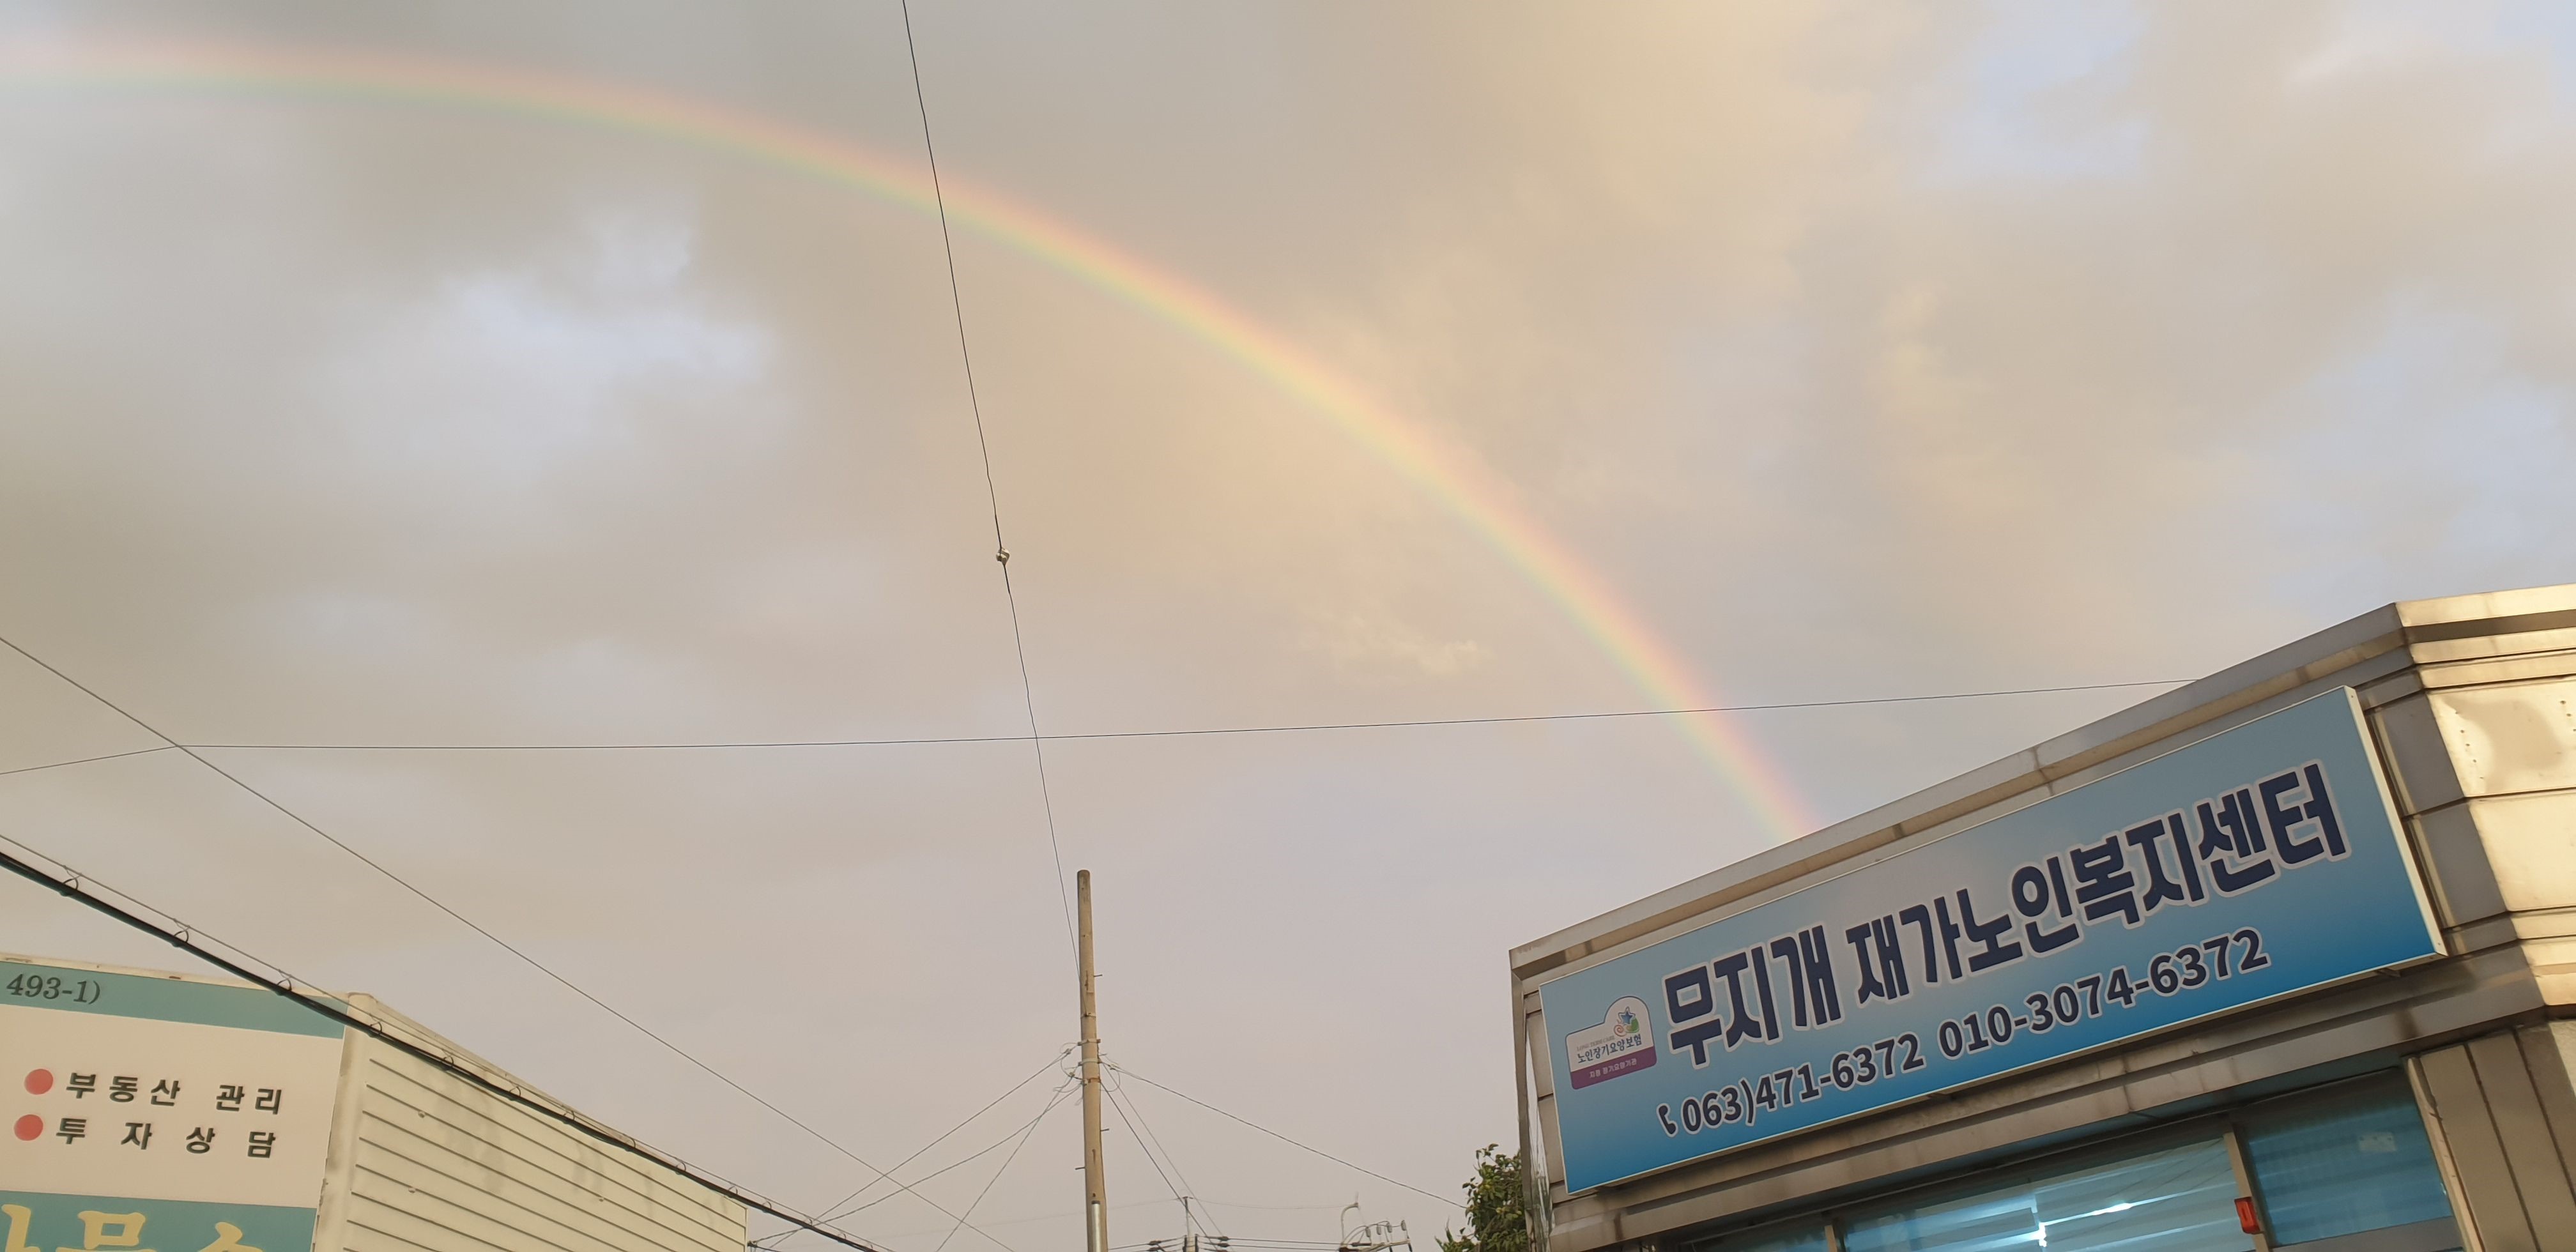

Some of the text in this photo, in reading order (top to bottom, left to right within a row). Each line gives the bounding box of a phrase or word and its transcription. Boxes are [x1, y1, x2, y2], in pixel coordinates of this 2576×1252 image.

[1664, 763, 2347, 1066] 무지개 재가노인복지센터
[6, 973, 100, 1004] 493-1)
[1577, 1034, 1642, 1064] 노인장기요양보험
[1682, 928, 2267, 1131] 063)471-6372 010-3074-6372
[66, 1073, 282, 1114] 부동산 관리
